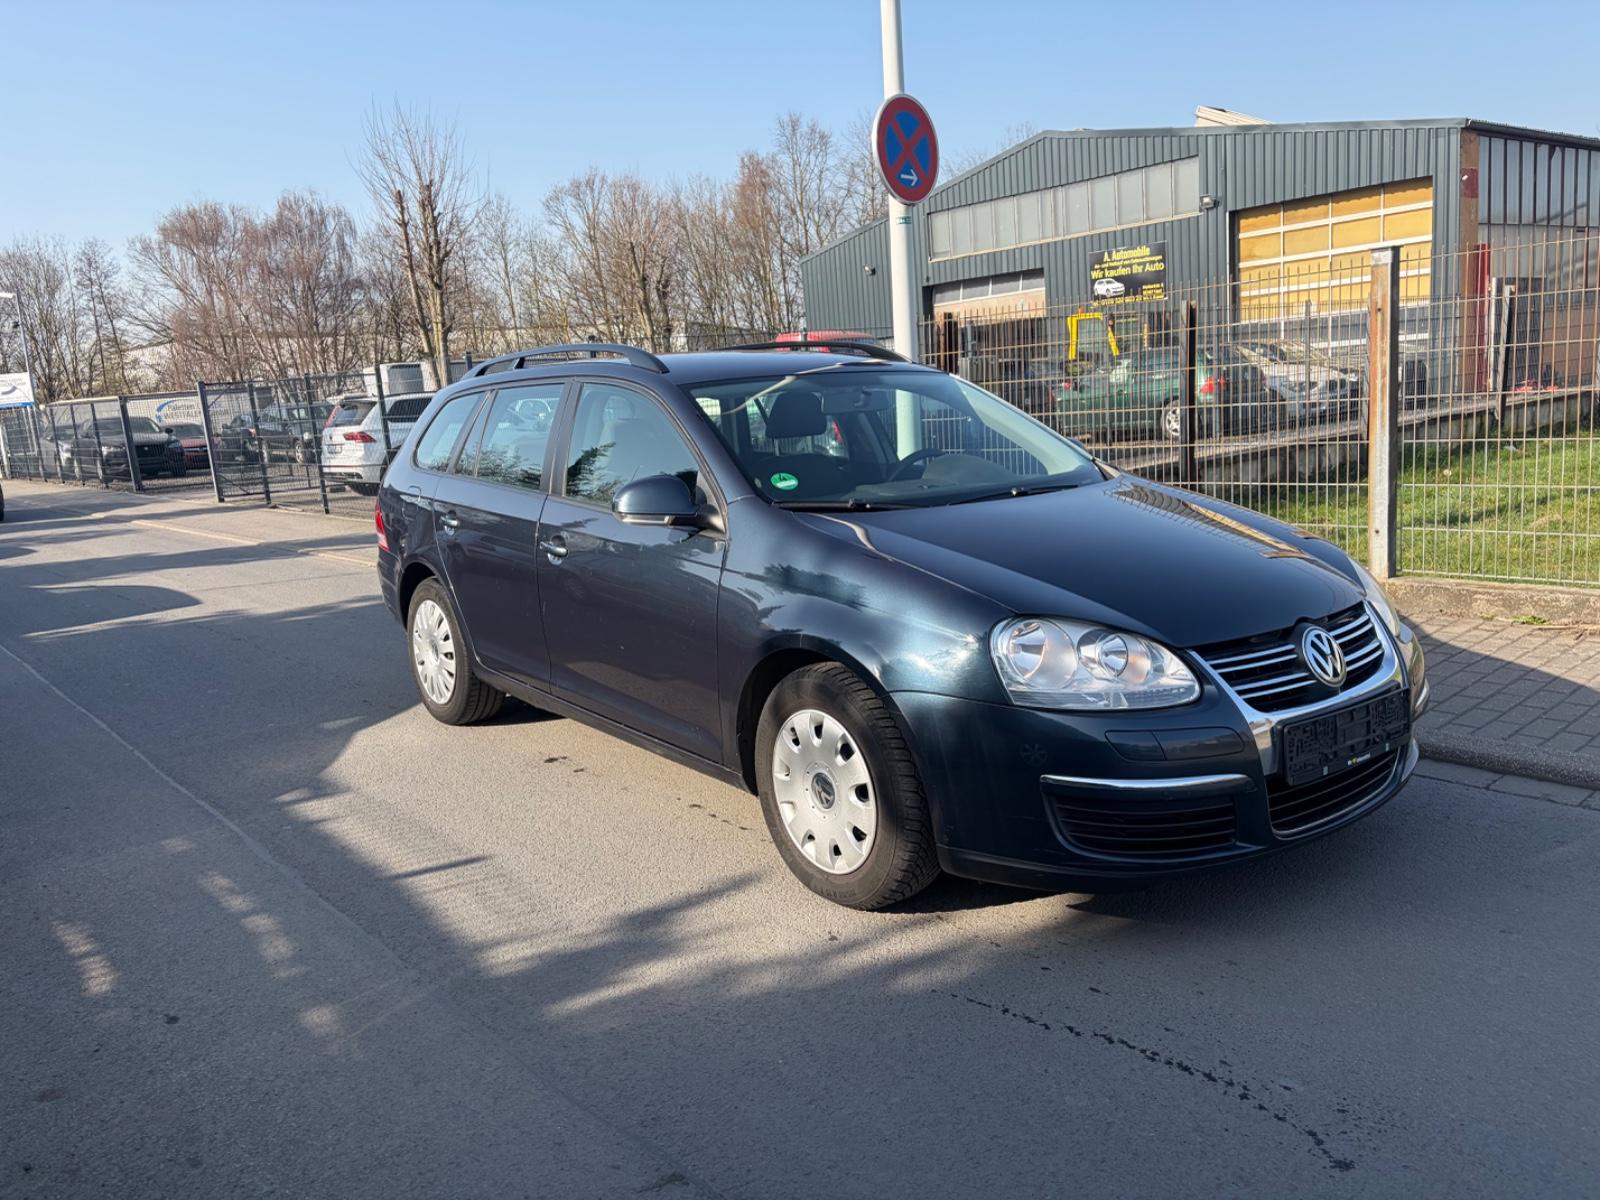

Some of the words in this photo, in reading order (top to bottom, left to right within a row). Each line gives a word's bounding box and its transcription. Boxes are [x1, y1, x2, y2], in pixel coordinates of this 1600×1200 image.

[1112, 245, 1150, 261] Automobile
[1091, 270, 1104, 280] Wir
[1105, 266, 1131, 277] kaufen
[1132, 264, 1143, 274] Ihr
[1145, 262, 1164, 272] Auto
[1305, 628, 1344, 684] VW
